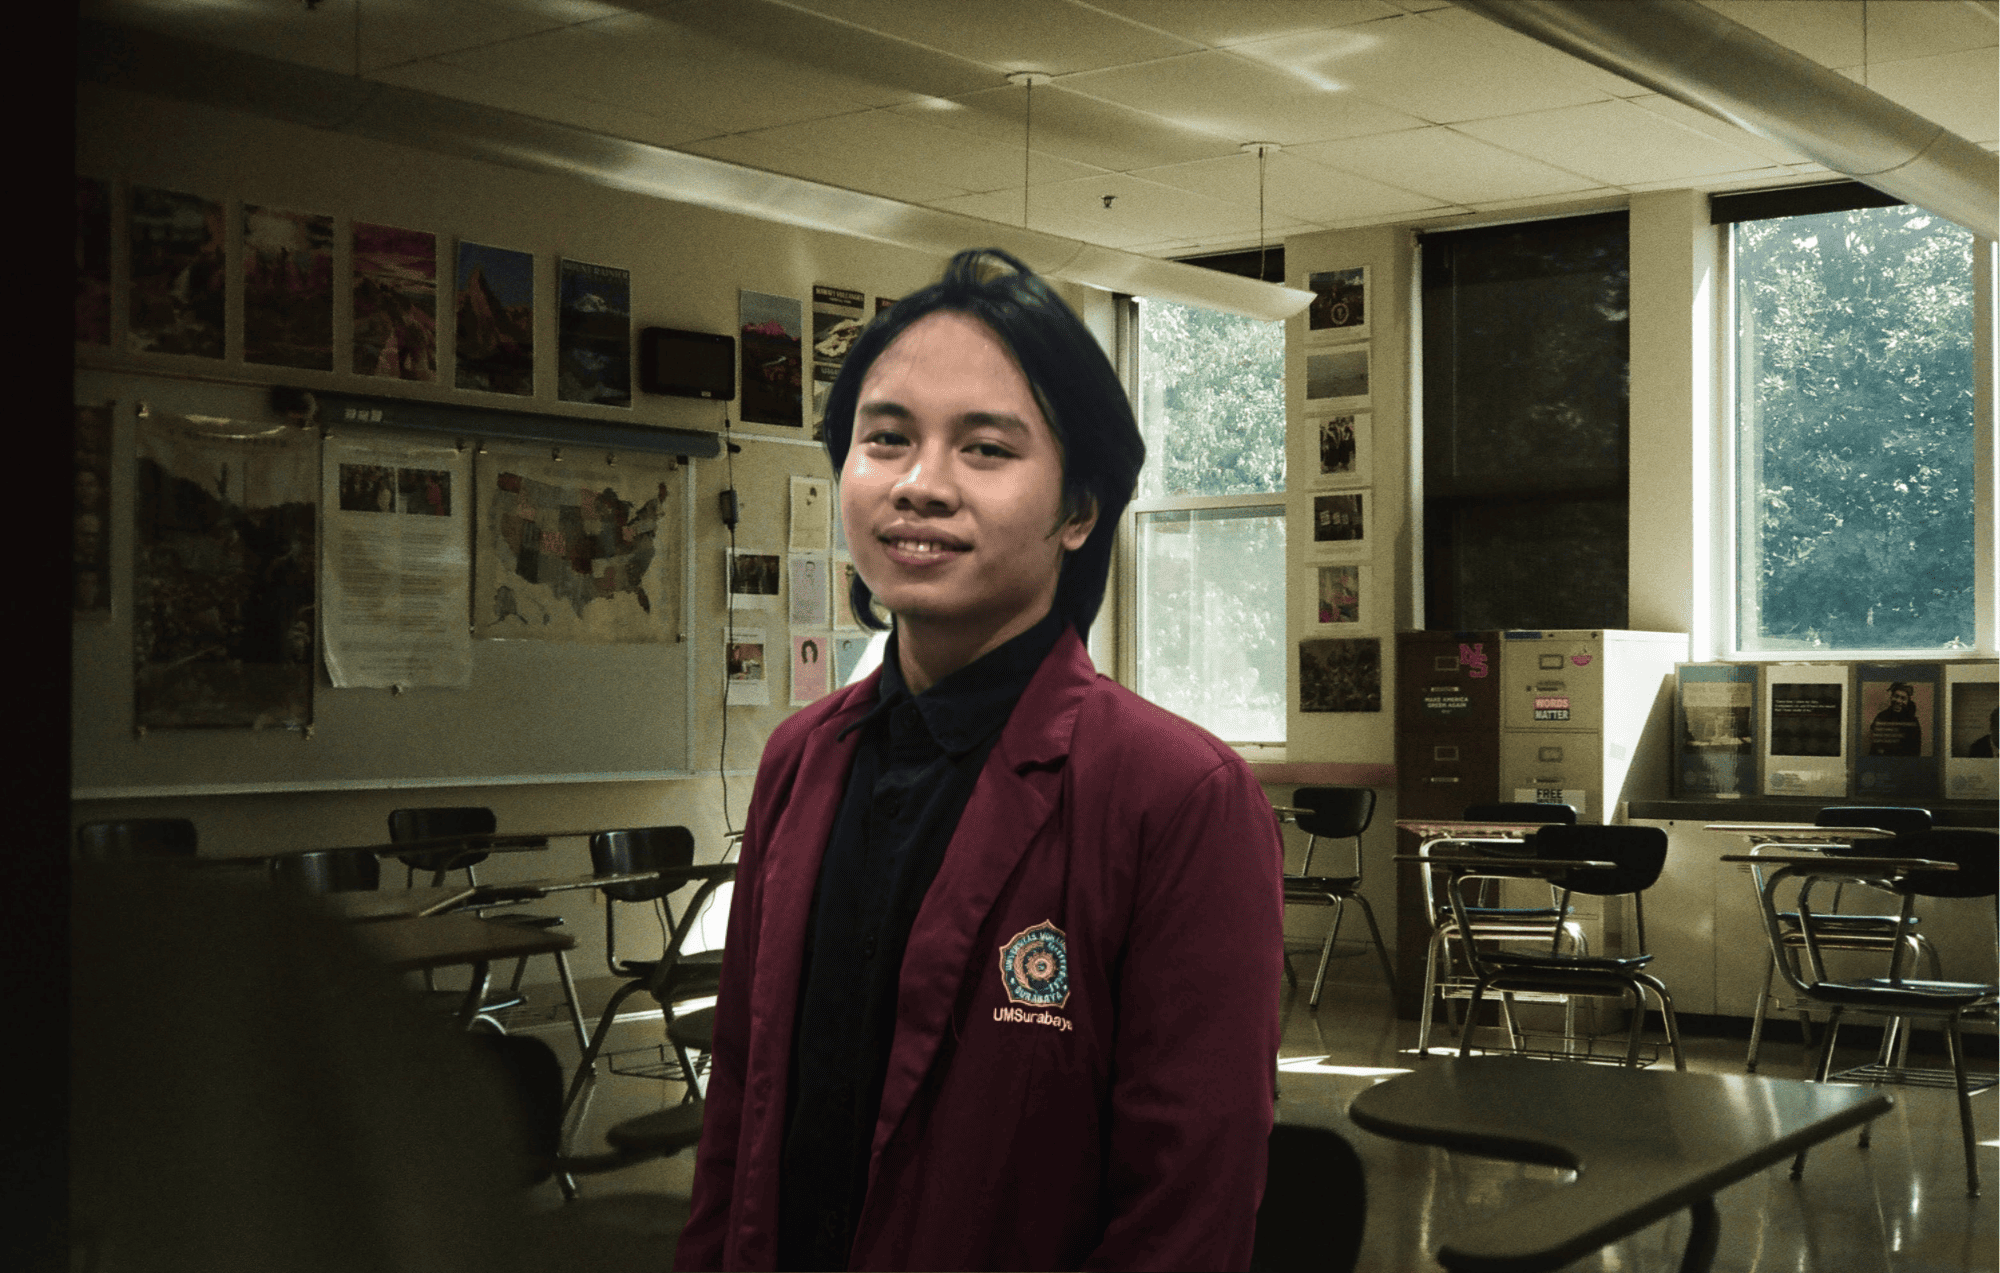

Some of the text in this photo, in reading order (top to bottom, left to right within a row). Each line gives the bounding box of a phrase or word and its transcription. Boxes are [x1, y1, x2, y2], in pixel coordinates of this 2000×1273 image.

[1535, 698, 1569, 708] WORDS
[1535, 710, 1569, 720] MATTER
[1536, 789, 1563, 798] FREE
